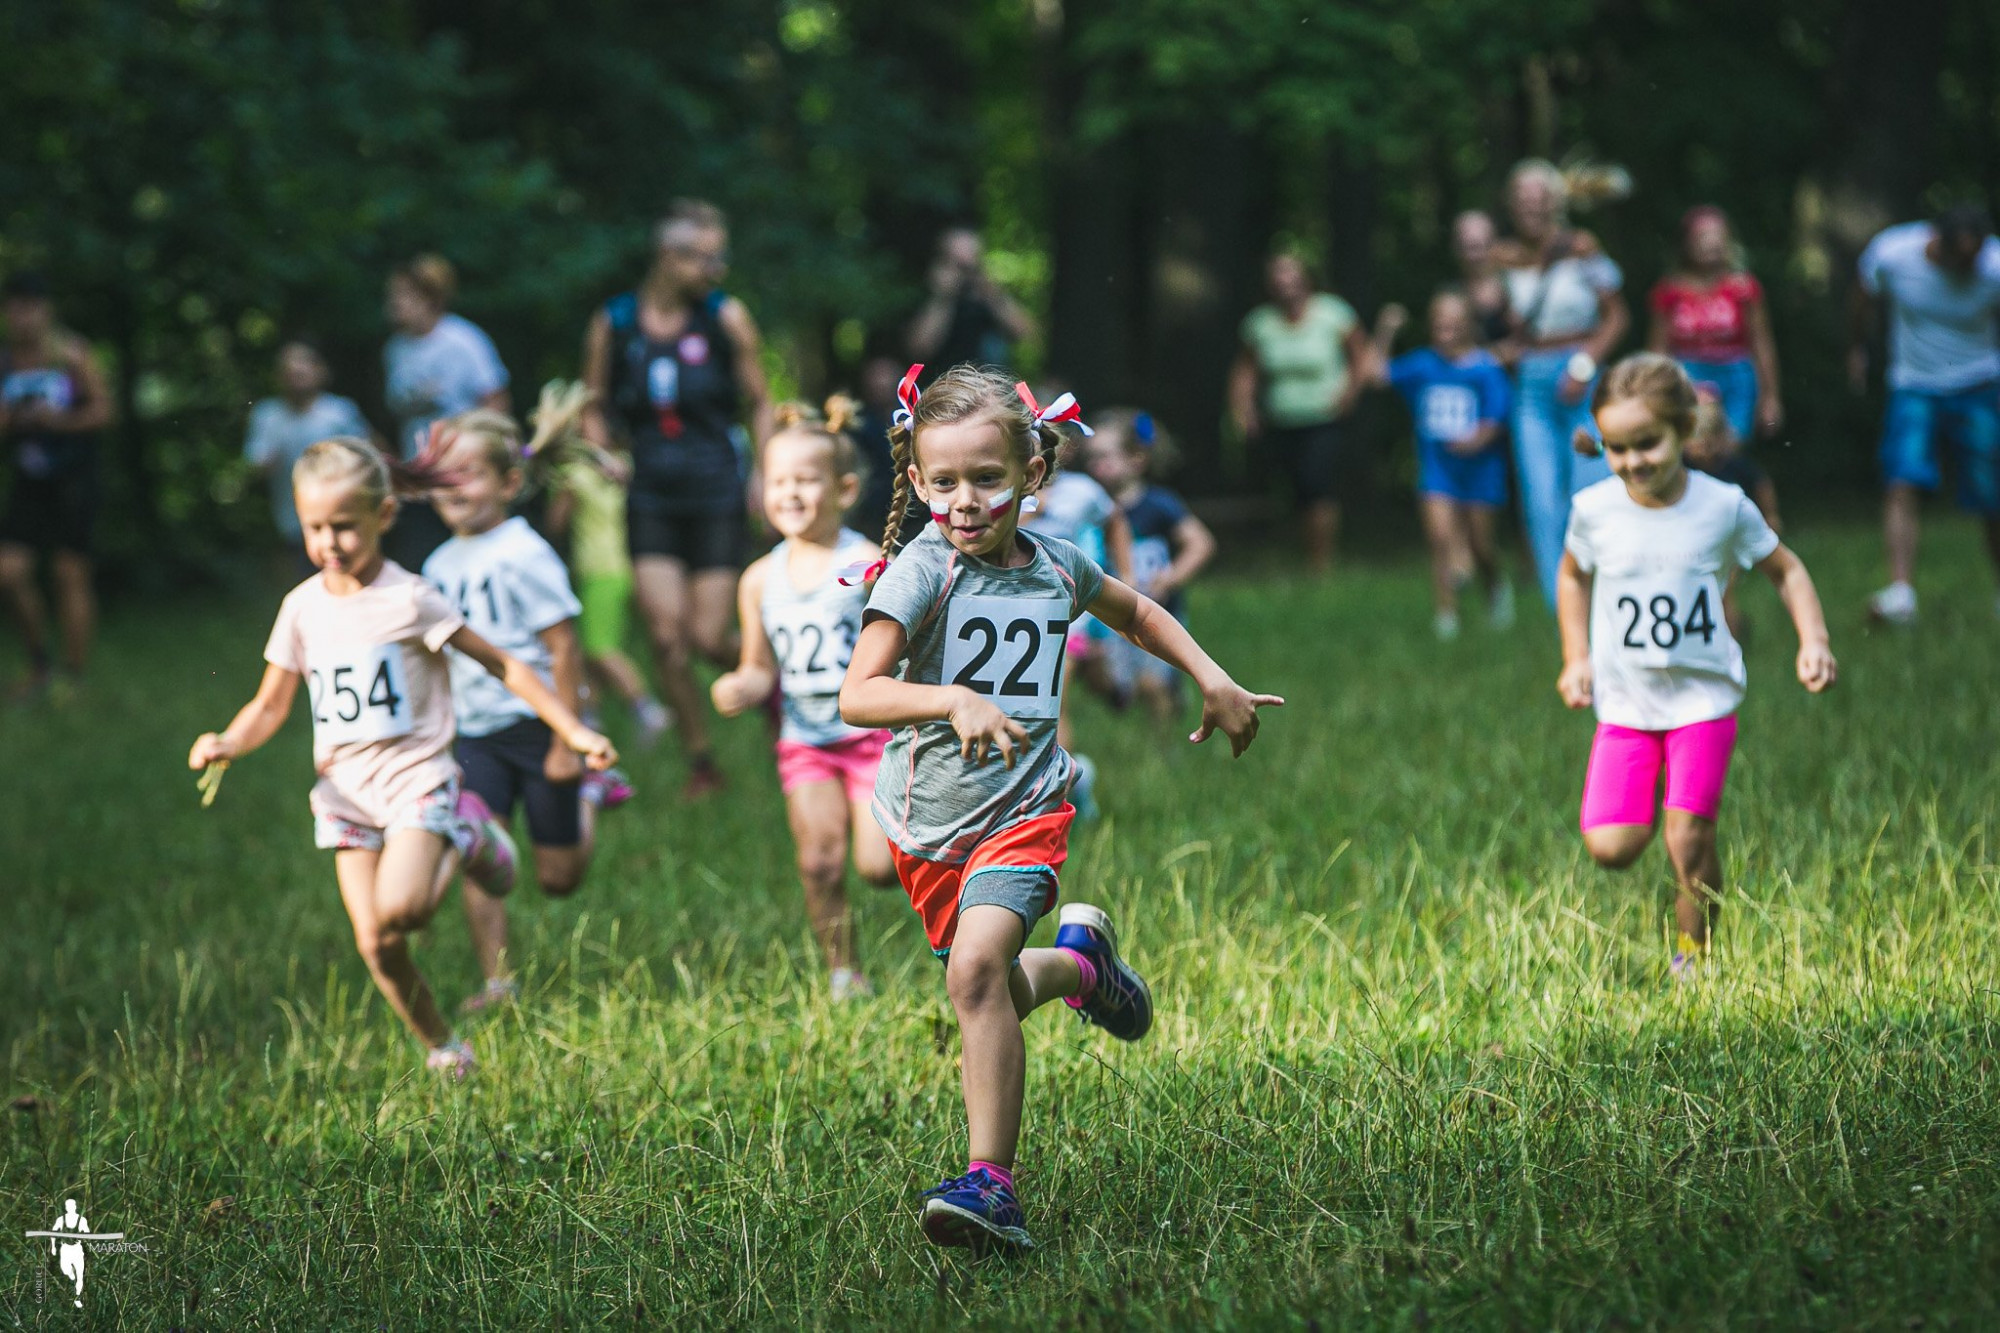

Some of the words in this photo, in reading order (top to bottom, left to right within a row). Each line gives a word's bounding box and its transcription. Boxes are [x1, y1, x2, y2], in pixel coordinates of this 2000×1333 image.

[770, 616, 857, 674] 223
[1618, 586, 1717, 650] 284
[951, 616, 1070, 697] 227
[309, 658, 402, 723] 254
